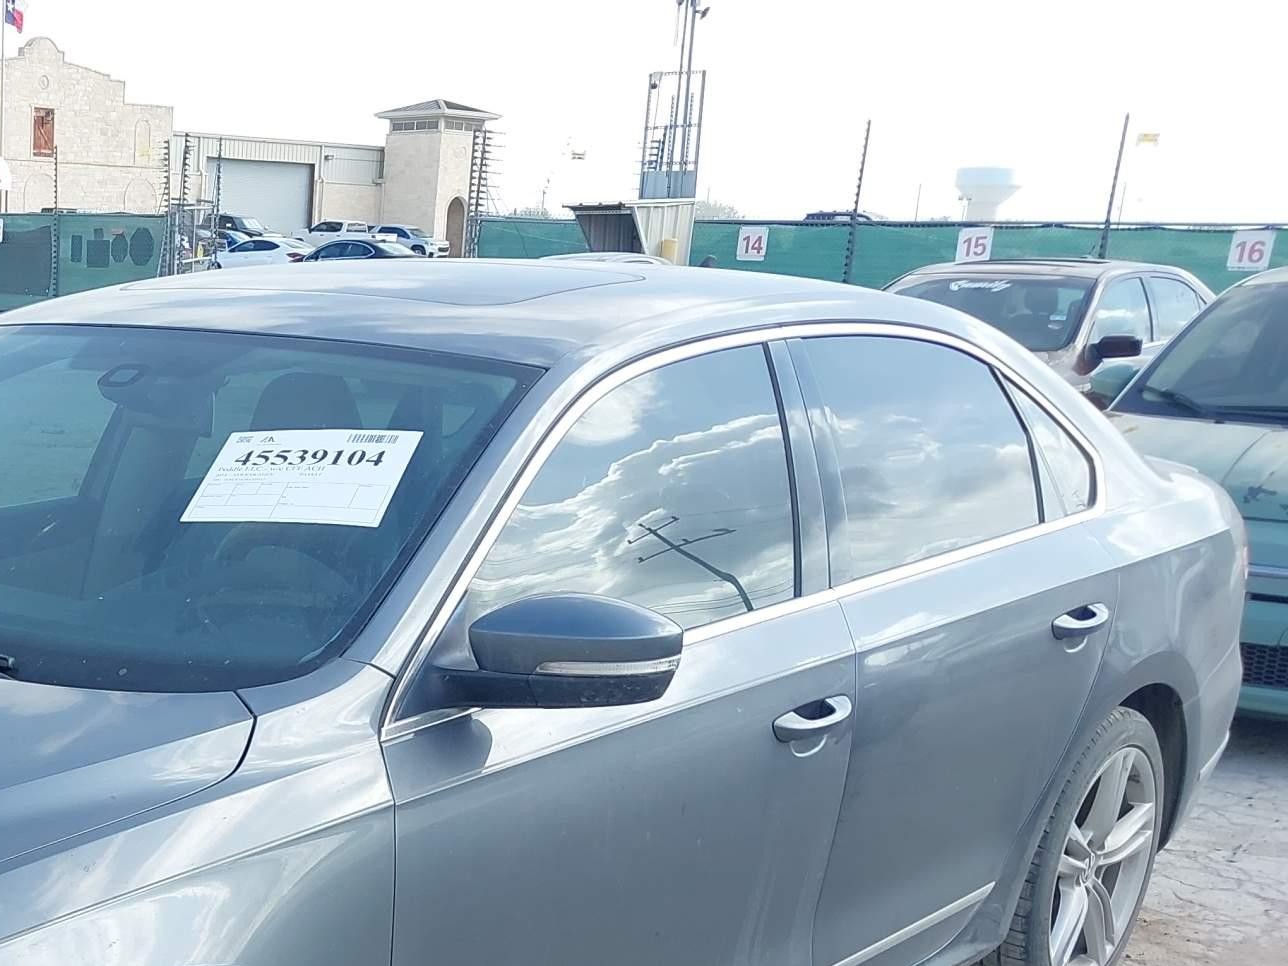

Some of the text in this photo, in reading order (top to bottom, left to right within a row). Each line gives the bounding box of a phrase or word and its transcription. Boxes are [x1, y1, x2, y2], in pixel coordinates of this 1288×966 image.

[742, 235, 764, 255] 14
[962, 235, 988, 257] 15
[1235, 240, 1267, 264] 16
[234, 449, 386, 466] 45539104
